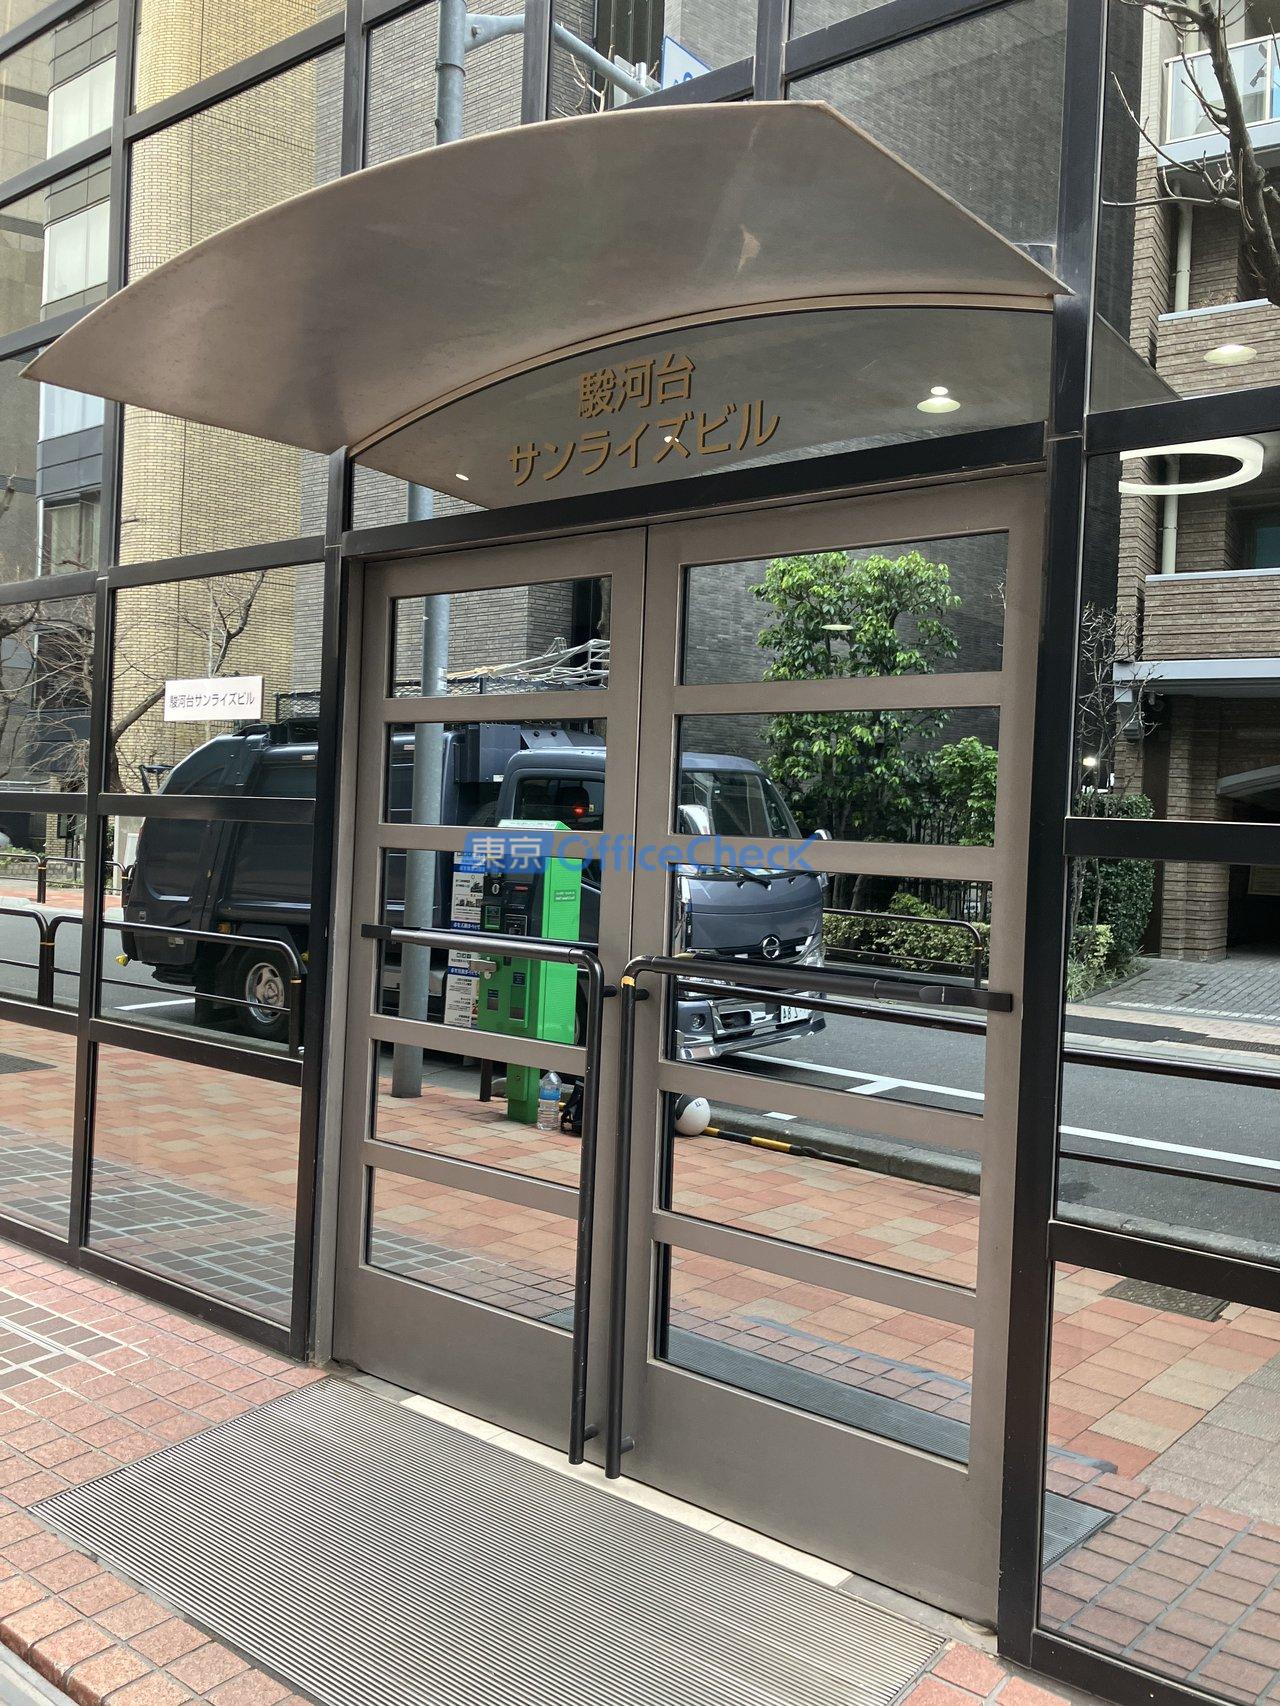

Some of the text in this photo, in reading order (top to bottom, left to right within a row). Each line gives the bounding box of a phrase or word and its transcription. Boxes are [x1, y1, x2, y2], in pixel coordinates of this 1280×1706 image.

[577, 352, 696, 419] 駿河台
[509, 400, 780, 486] サンライズビル
[169, 691, 256, 709] 駿河台サンライズビル
